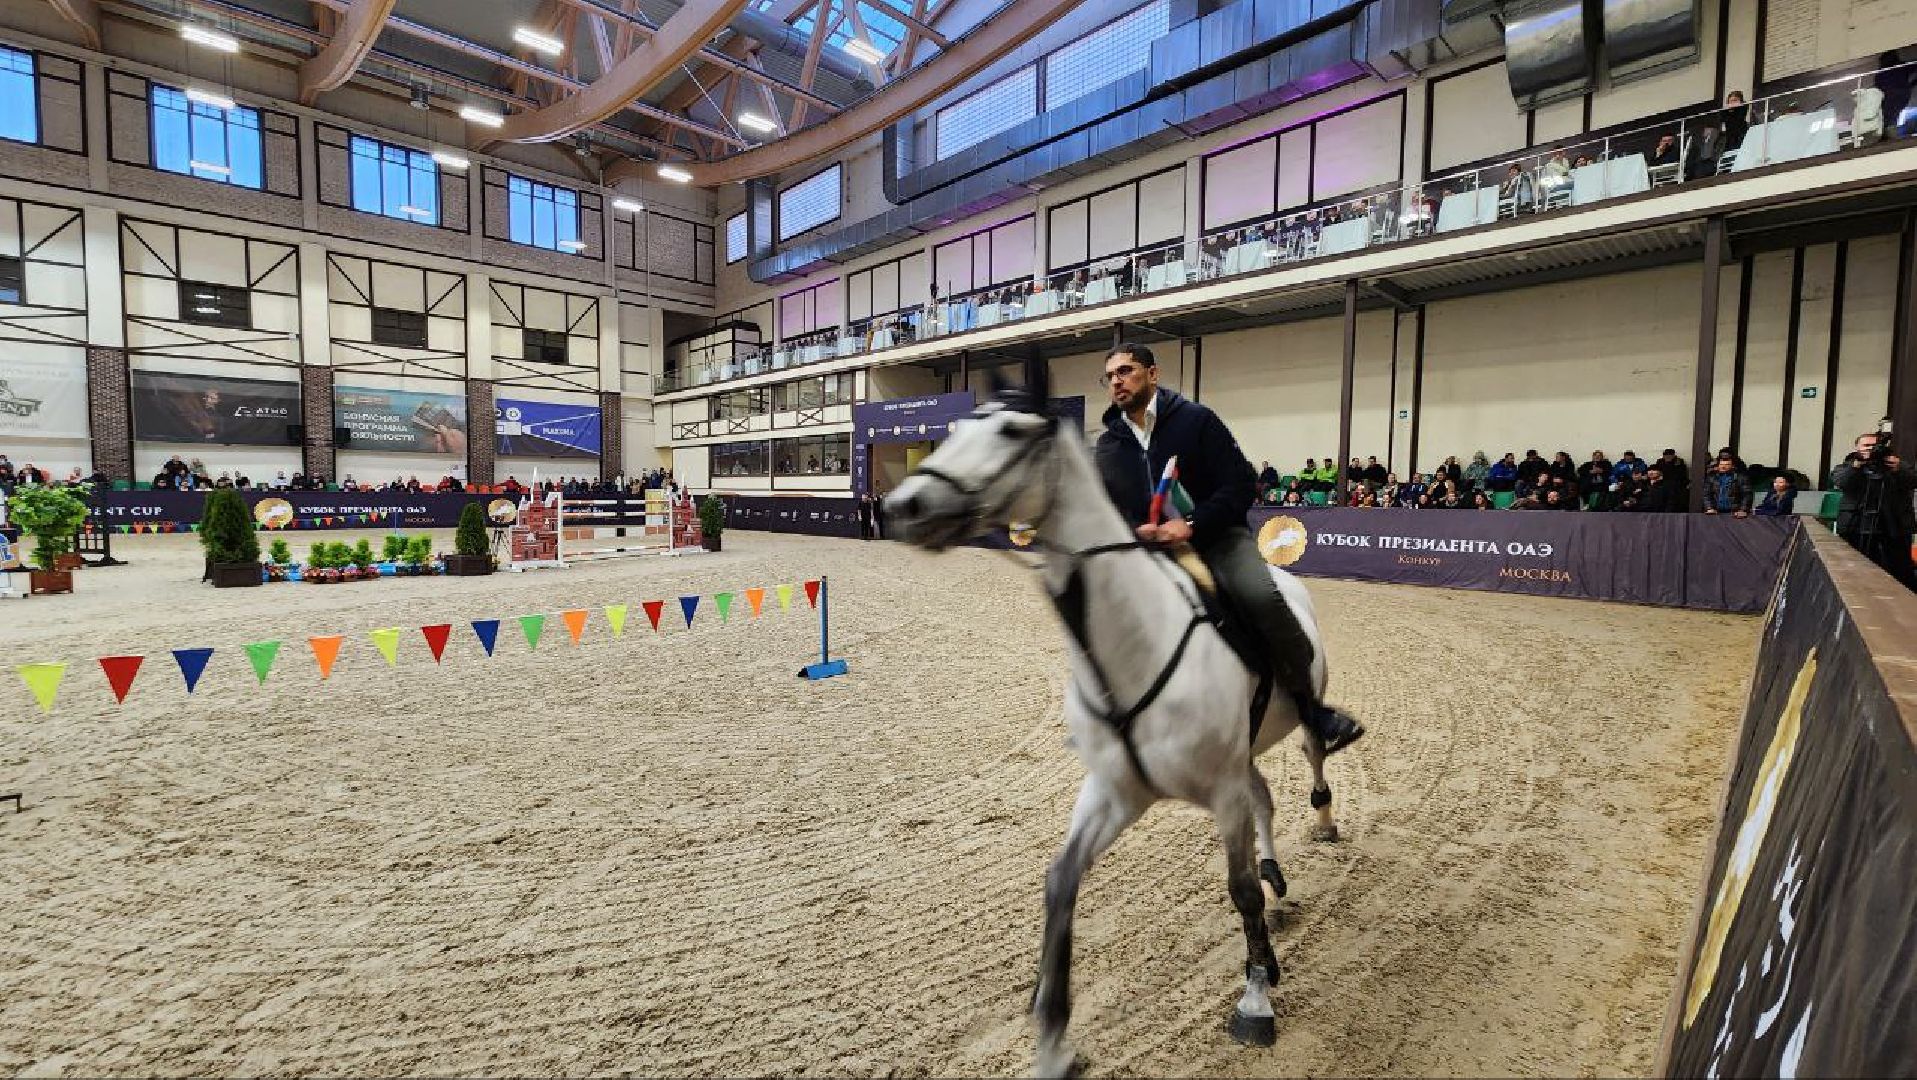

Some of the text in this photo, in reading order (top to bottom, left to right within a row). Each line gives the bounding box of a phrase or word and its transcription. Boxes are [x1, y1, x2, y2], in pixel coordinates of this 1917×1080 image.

[343, 412, 400, 423] БОНУСНАЯ
[343, 421, 408, 432] ПРОГРАММА
[350, 431, 415, 441] ОЯЛЬНОСТИ
[130, 506, 163, 516] CUP
[299, 506, 335, 514] КУБОК
[1316, 533, 1554, 558] КУБОК ПРЕЗИДЕНТА ОАЭ
[1499, 567, 1571, 582] МОСКВА
